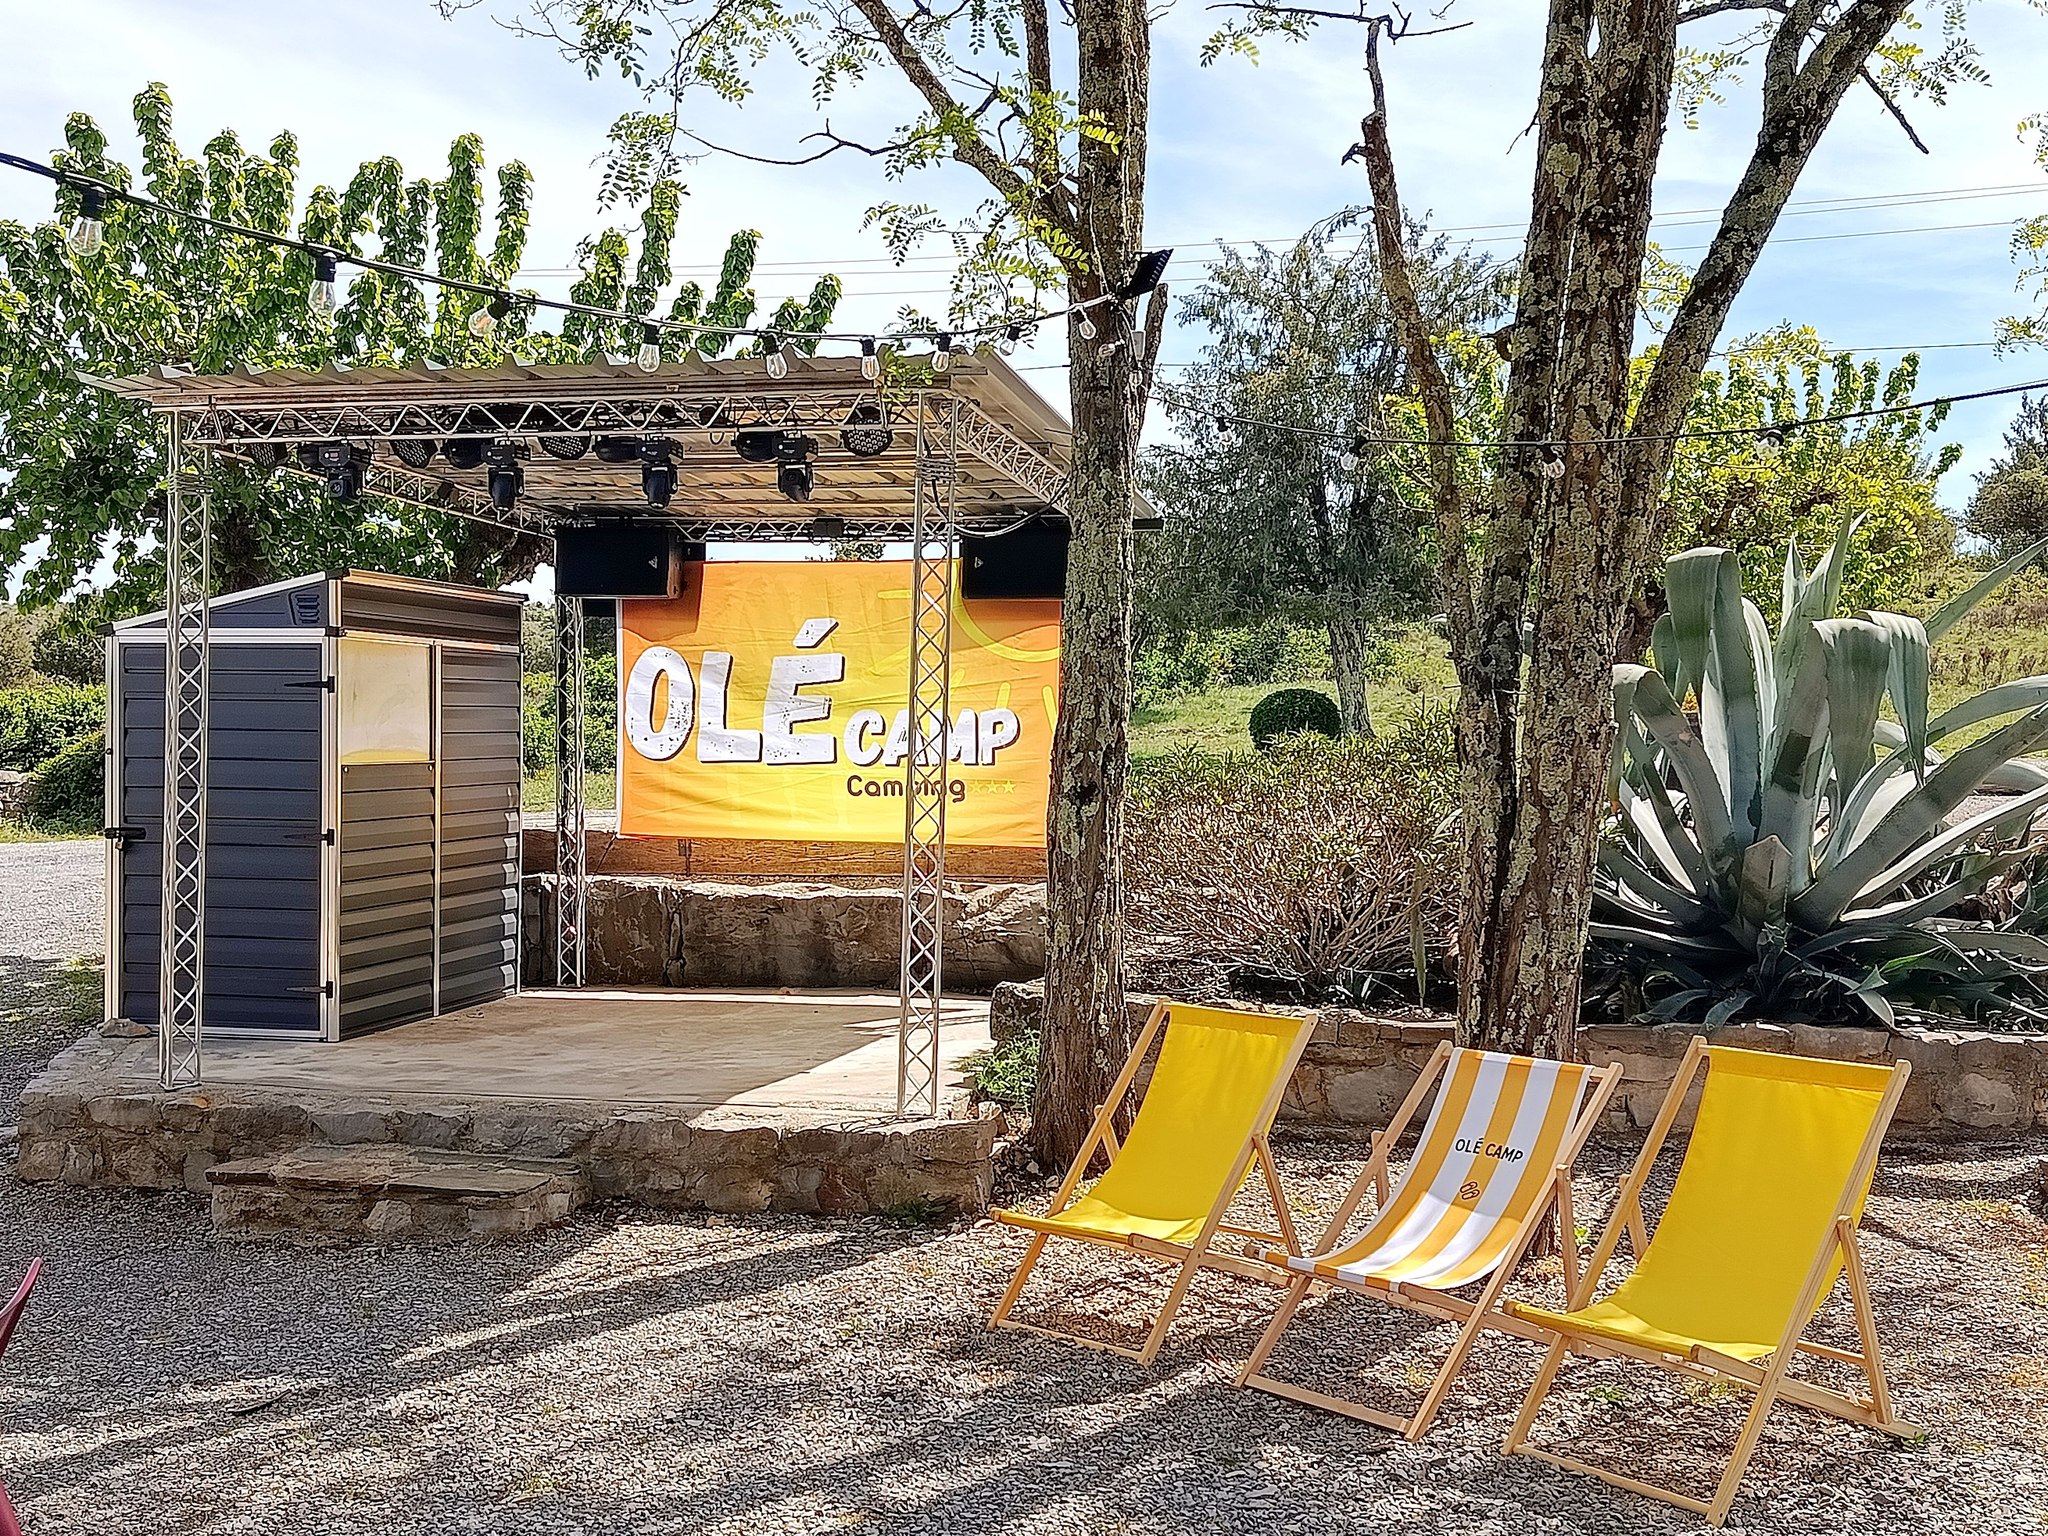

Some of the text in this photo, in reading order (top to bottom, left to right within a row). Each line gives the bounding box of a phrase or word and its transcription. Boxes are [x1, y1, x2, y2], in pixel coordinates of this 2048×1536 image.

[625, 617, 1021, 767] OLÉ CAMP
[1455, 1137, 1524, 1163] OLÉ CAMP
